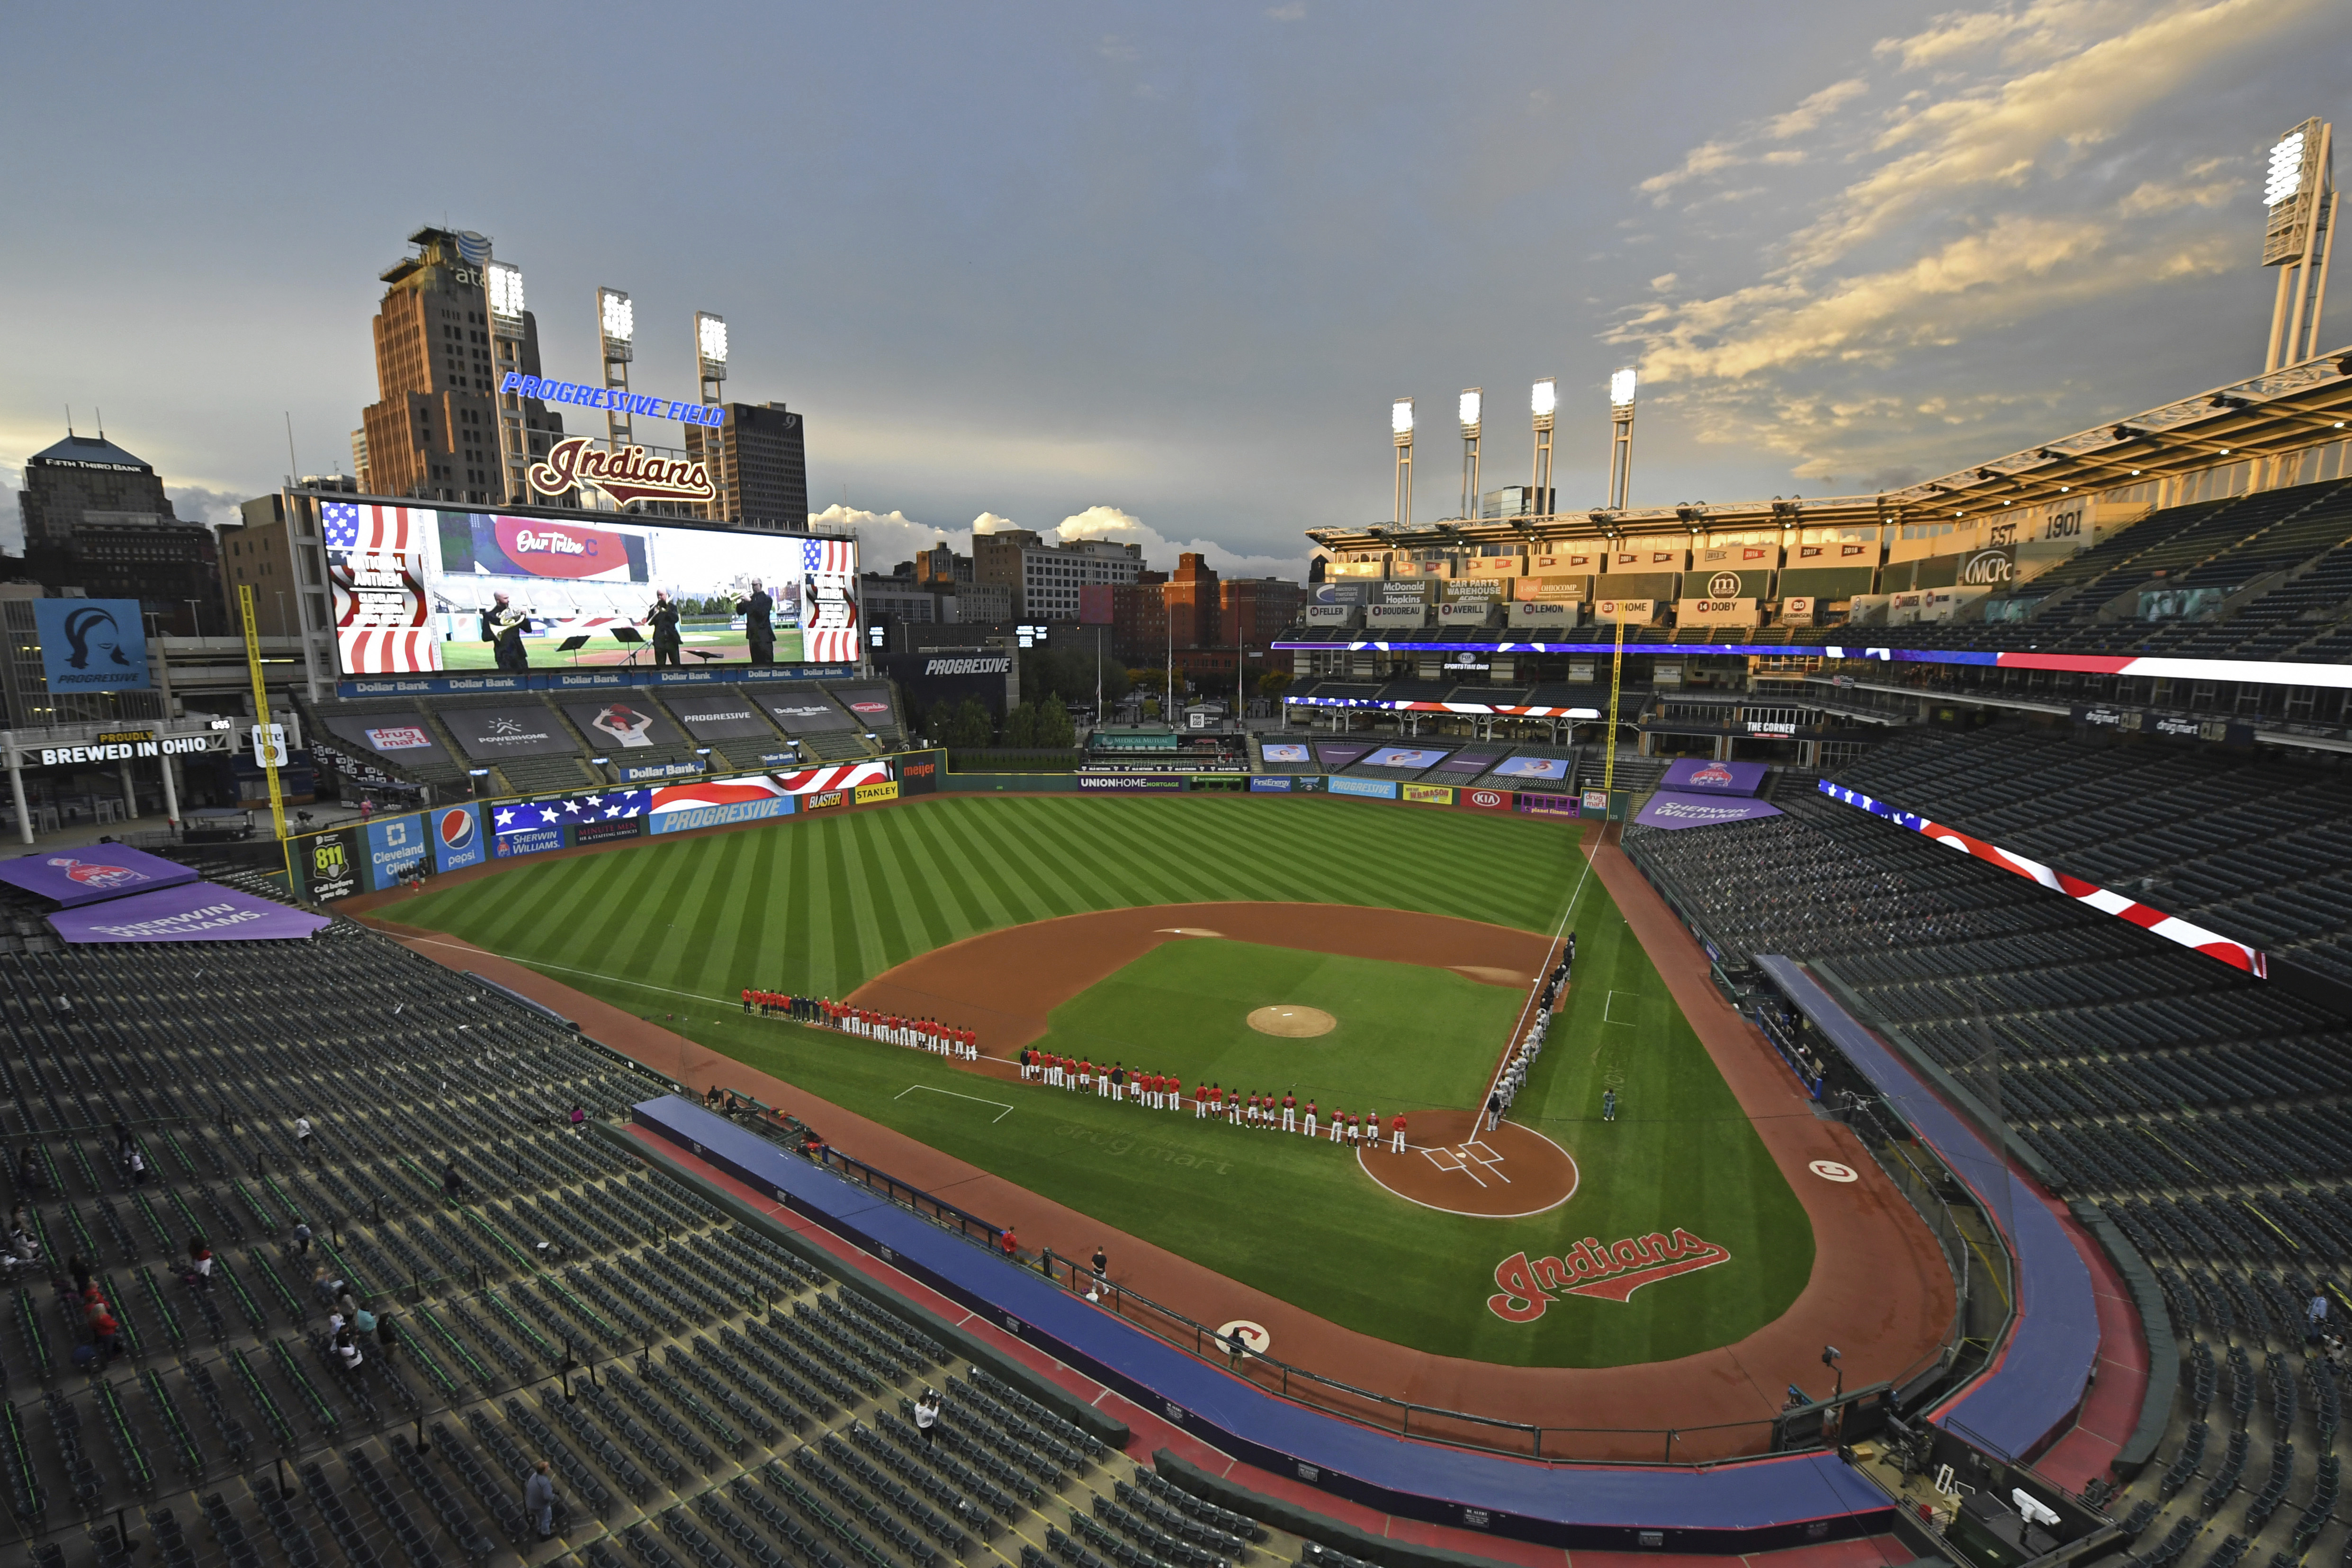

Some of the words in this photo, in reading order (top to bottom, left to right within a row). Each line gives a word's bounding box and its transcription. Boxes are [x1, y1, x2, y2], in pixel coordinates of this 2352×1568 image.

[500, 371, 663, 417] PROGRESSIVE
[665, 401, 726, 428] FIELD
[45, 458, 76, 467] FIFTH
[77, 461, 112, 470] THIRD
[113, 464, 142, 473] BANK
[529, 437, 716, 505] Indians
[2046, 510, 2082, 539] 1901
[1991, 523, 2018, 546] EST.
[517, 530, 548, 552] Our
[539, 531, 584, 554] Tribe
[585, 538, 598, 556] C
[347, 555, 406, 571] NATIONAL
[354, 572, 403, 587] ANTHEM
[1383, 581, 1425, 591] McDonald
[1447, 587, 1501, 595] WAREHOUSE
[1386, 595, 1420, 604] Hopkins
[1711, 601, 1737, 611] DOBY
[1382, 607, 1420, 615] BOUDREAU
[1453, 605, 1484, 614] AVERILL
[1535, 604, 1563, 613] LEMON
[1616, 603, 1647, 611] THOME
[925, 658, 1011, 675] PROGRESSIVE
[58, 673, 140, 683] PROGRESSIVE
[449, 679, 484, 689] Dollar
[485, 678, 516, 687] Bank
[562, 676, 592, 685] Dollar
[593, 675, 619, 683] Bank
[662, 672, 688, 681] Dollar
[689, 672, 711, 680] Bank
[356, 682, 395, 693] Dollar
[397, 681, 430, 691] Bank
[684, 712, 751, 722] PROGRESSIVE
[1747, 721, 1762, 731] THE
[1763, 723, 1795, 734] CORNER
[100, 731, 153, 743] PROUDLY
[374, 729, 415, 743] drug
[383, 736, 426, 747] mart
[478, 733, 548, 744] POWERHOME
[42, 744, 133, 765] BREWED
[137, 741, 158, 757] IN
[162, 737, 206, 754] OHIO
[629, 767, 664, 779] Dollar
[666, 763, 695, 775] Bank
[904, 762, 935, 777] meijer
[1253, 779, 1290, 787] FirstEnergy
[1332, 780, 1391, 794] PROGRESSIVE
[532, 793, 561, 801] PROGRESSIVE
[857, 786, 897, 799] STANLEY
[1477, 794, 1495, 803] KIA
[1586, 792, 1603, 802] drug
[491, 798, 522, 806] PROGRESSIVE
[808, 792, 842, 809] BLASTER
[662, 798, 782, 832] PROGRESSIVE
[1661, 802, 1751, 814] SHERWIN
[579, 825, 614, 836] MINUTE
[618, 822, 637, 830] MEN
[513, 831, 557, 845] SHERWIN
[315, 845, 343, 869] 811
[373, 842, 424, 864] Cleveland
[449, 850, 475, 867] pepsi
[386, 860, 415, 875] Clinic
[314, 883, 329, 893] Call
[329, 879, 354, 890] before
[320, 891, 334, 901] you
[90, 903, 236, 934] SHERWIN
[1139, 1145, 1234, 1175] mart
[1815, 1163, 1850, 1177] C
[1487, 1228, 1731, 1323] Indians
